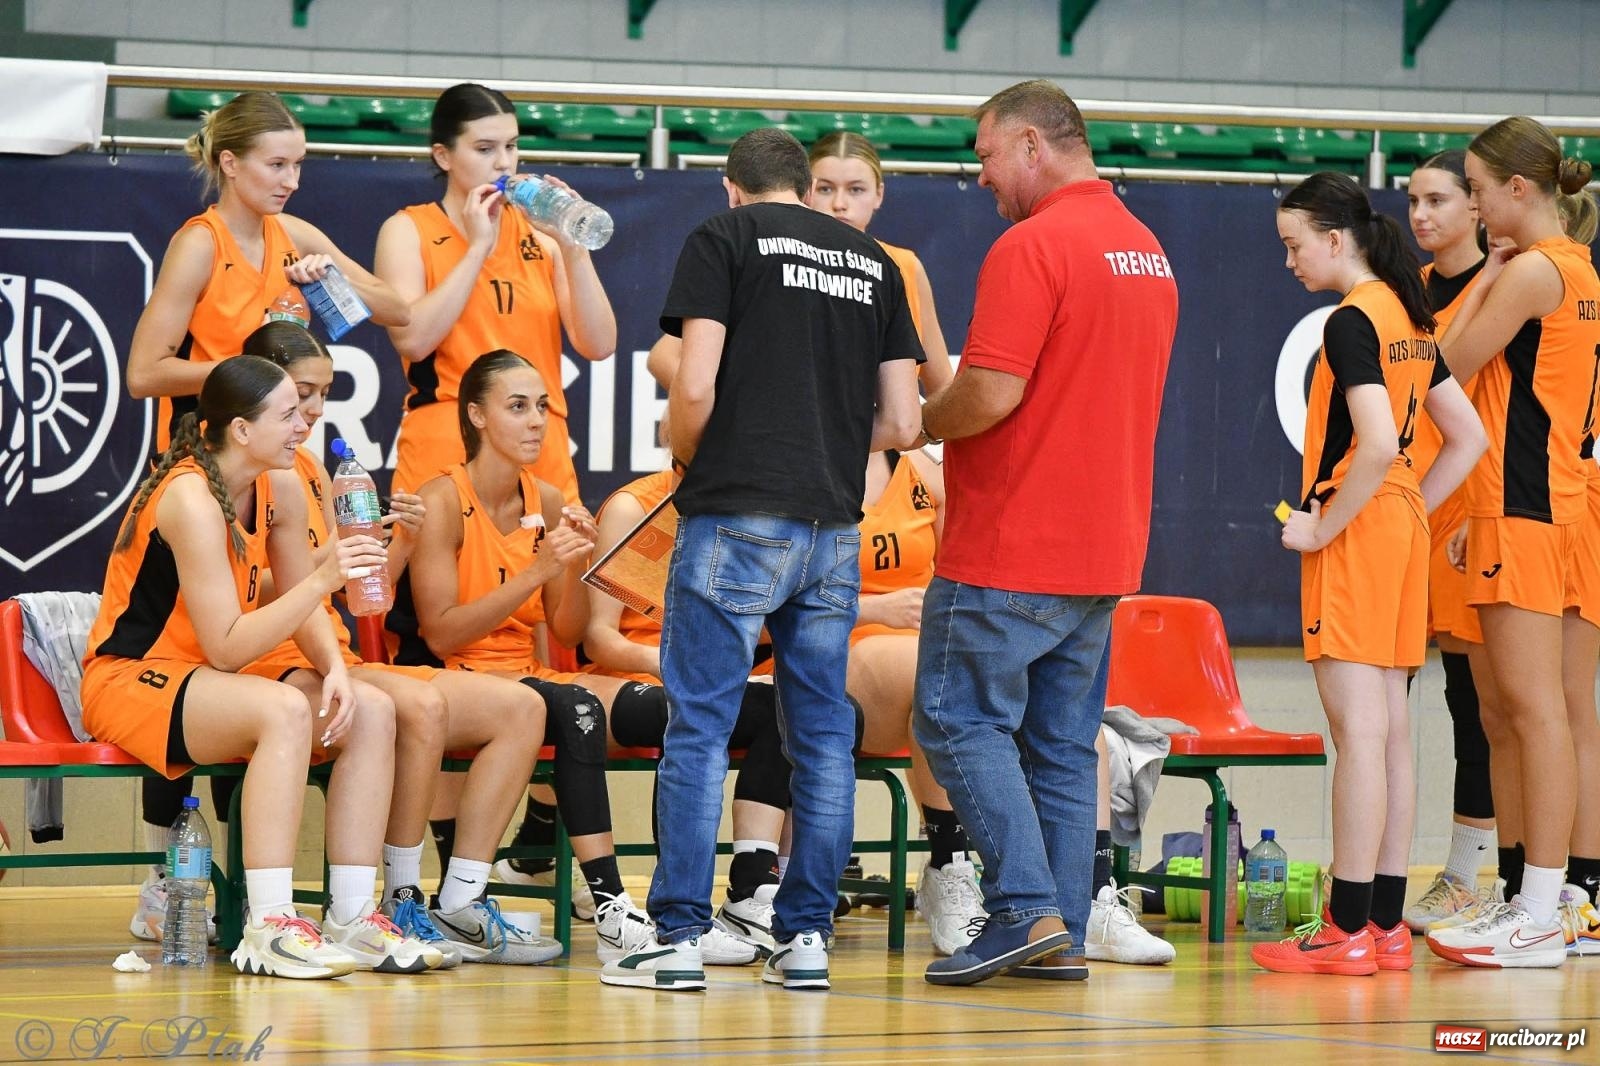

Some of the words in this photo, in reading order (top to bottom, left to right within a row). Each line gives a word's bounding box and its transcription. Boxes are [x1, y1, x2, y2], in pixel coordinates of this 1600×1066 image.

[757, 237, 844, 268] UNIWERSYTET
[1103, 250, 1175, 281] TRENER
[490, 279, 513, 315] 17
[782, 263, 873, 305] KATOWICE
[1578, 300, 1596, 321] AZS
[1389, 339, 1408, 364] AZS
[872, 532, 900, 571] 21
[247, 564, 258, 603] 8
[137, 669, 169, 690] 8
